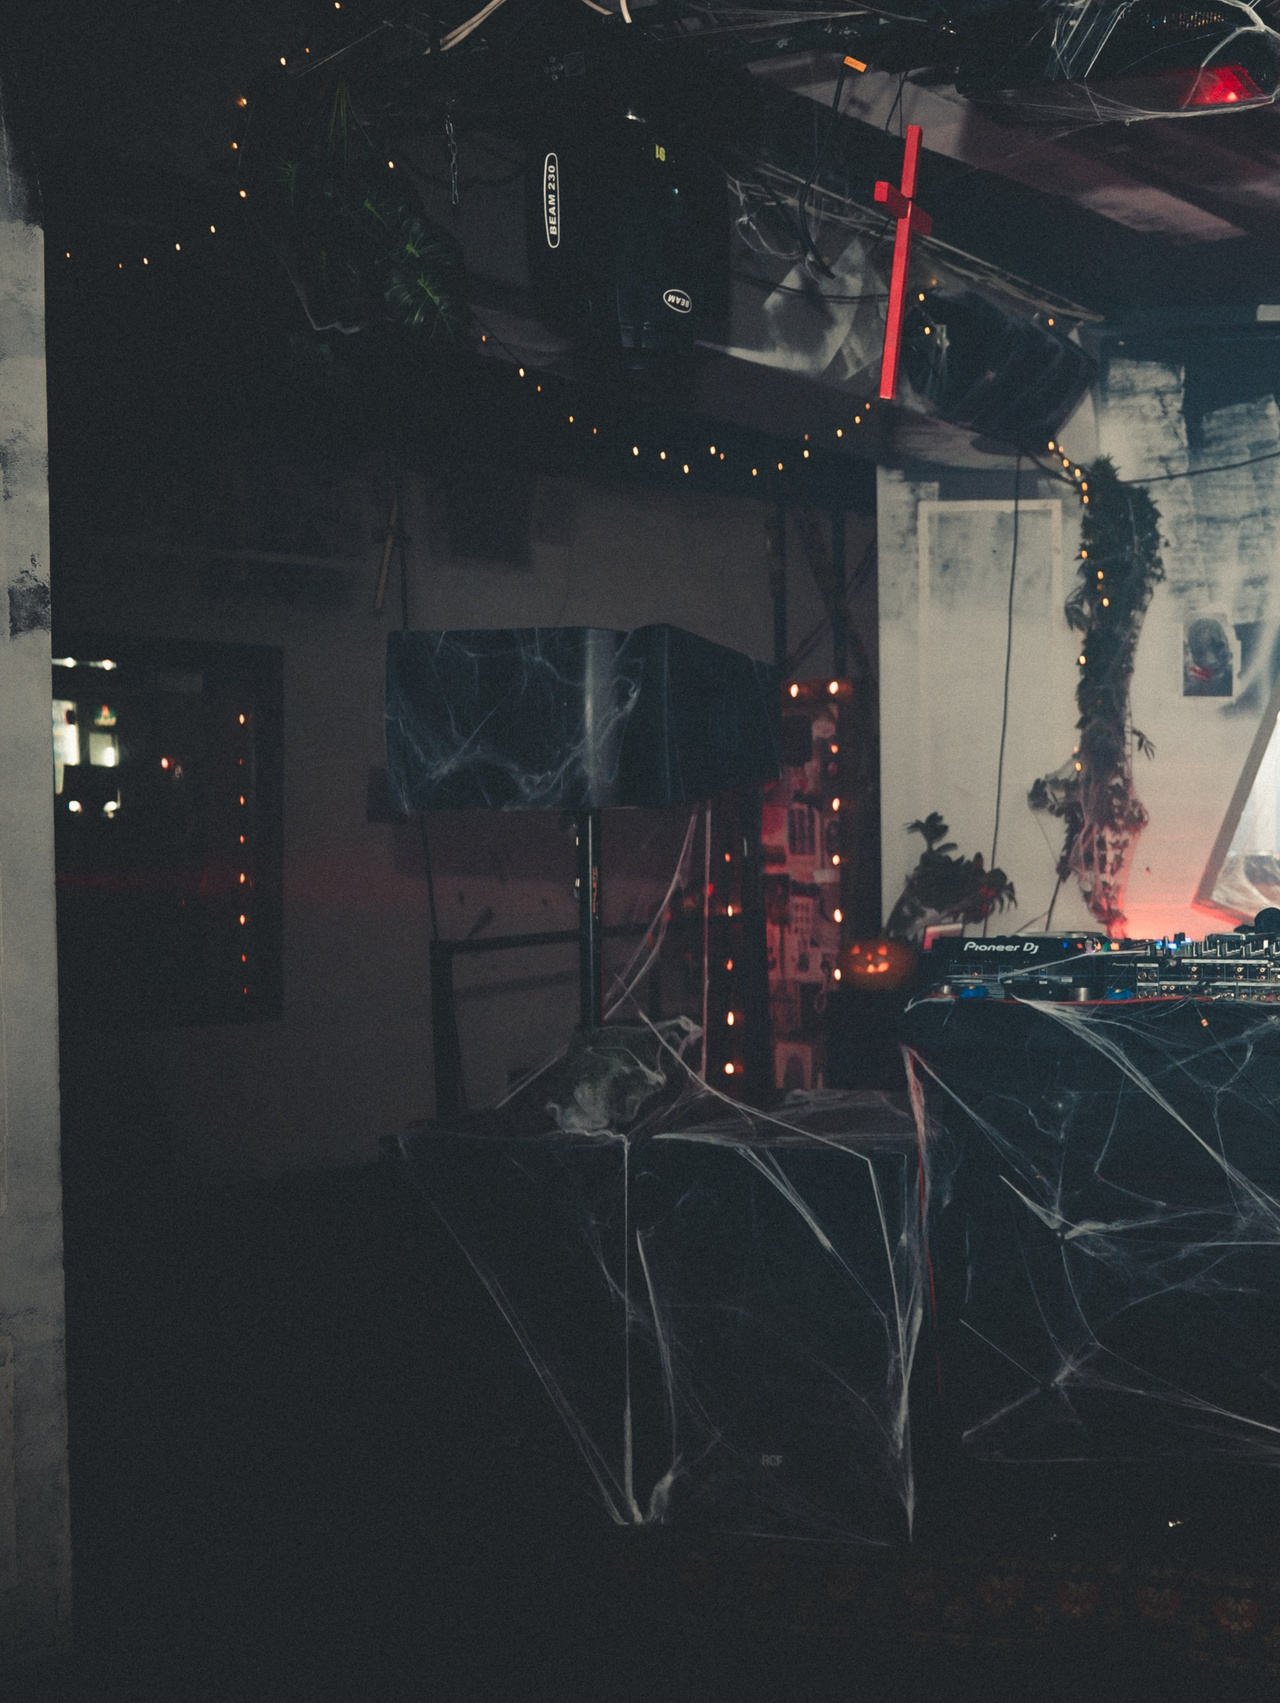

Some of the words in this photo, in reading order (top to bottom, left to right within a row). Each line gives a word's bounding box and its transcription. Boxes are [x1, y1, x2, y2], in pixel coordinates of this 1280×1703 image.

[547, 164, 556, 191] 230
[548, 194, 558, 235] BEAM
[667, 294, 690, 308] BEAM
[963, 941, 1020, 951] Pioneer
